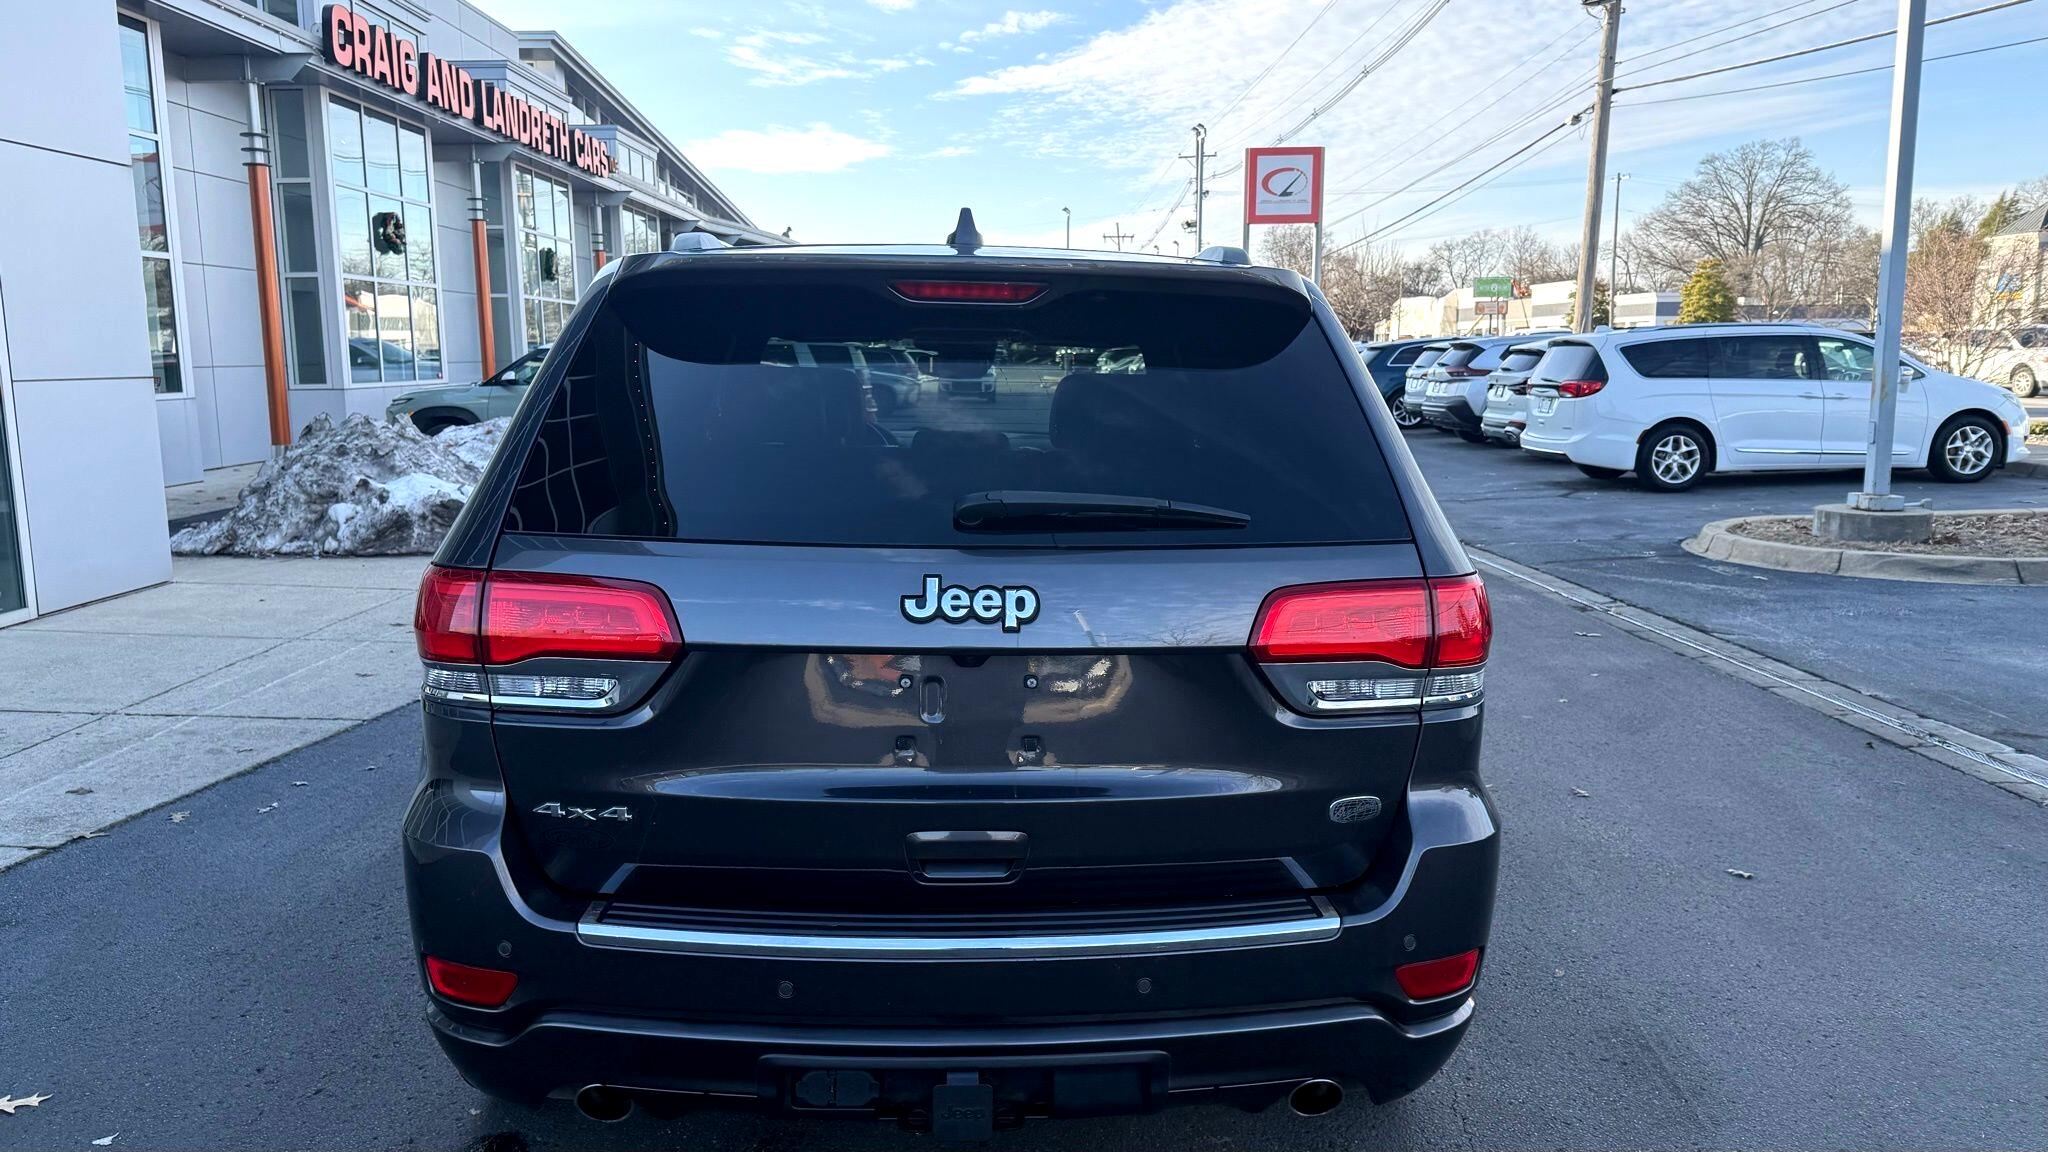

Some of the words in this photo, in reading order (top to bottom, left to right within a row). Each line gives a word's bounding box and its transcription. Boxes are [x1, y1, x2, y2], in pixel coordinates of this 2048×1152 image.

[331, 3, 419, 96] CRAIG
[427, 52, 475, 120] AND
[481, 79, 571, 163] LANDRETH
[574, 128, 610, 179] CARS
[902, 575, 1039, 631] Jeep
[532, 802, 633, 821] 4x4
